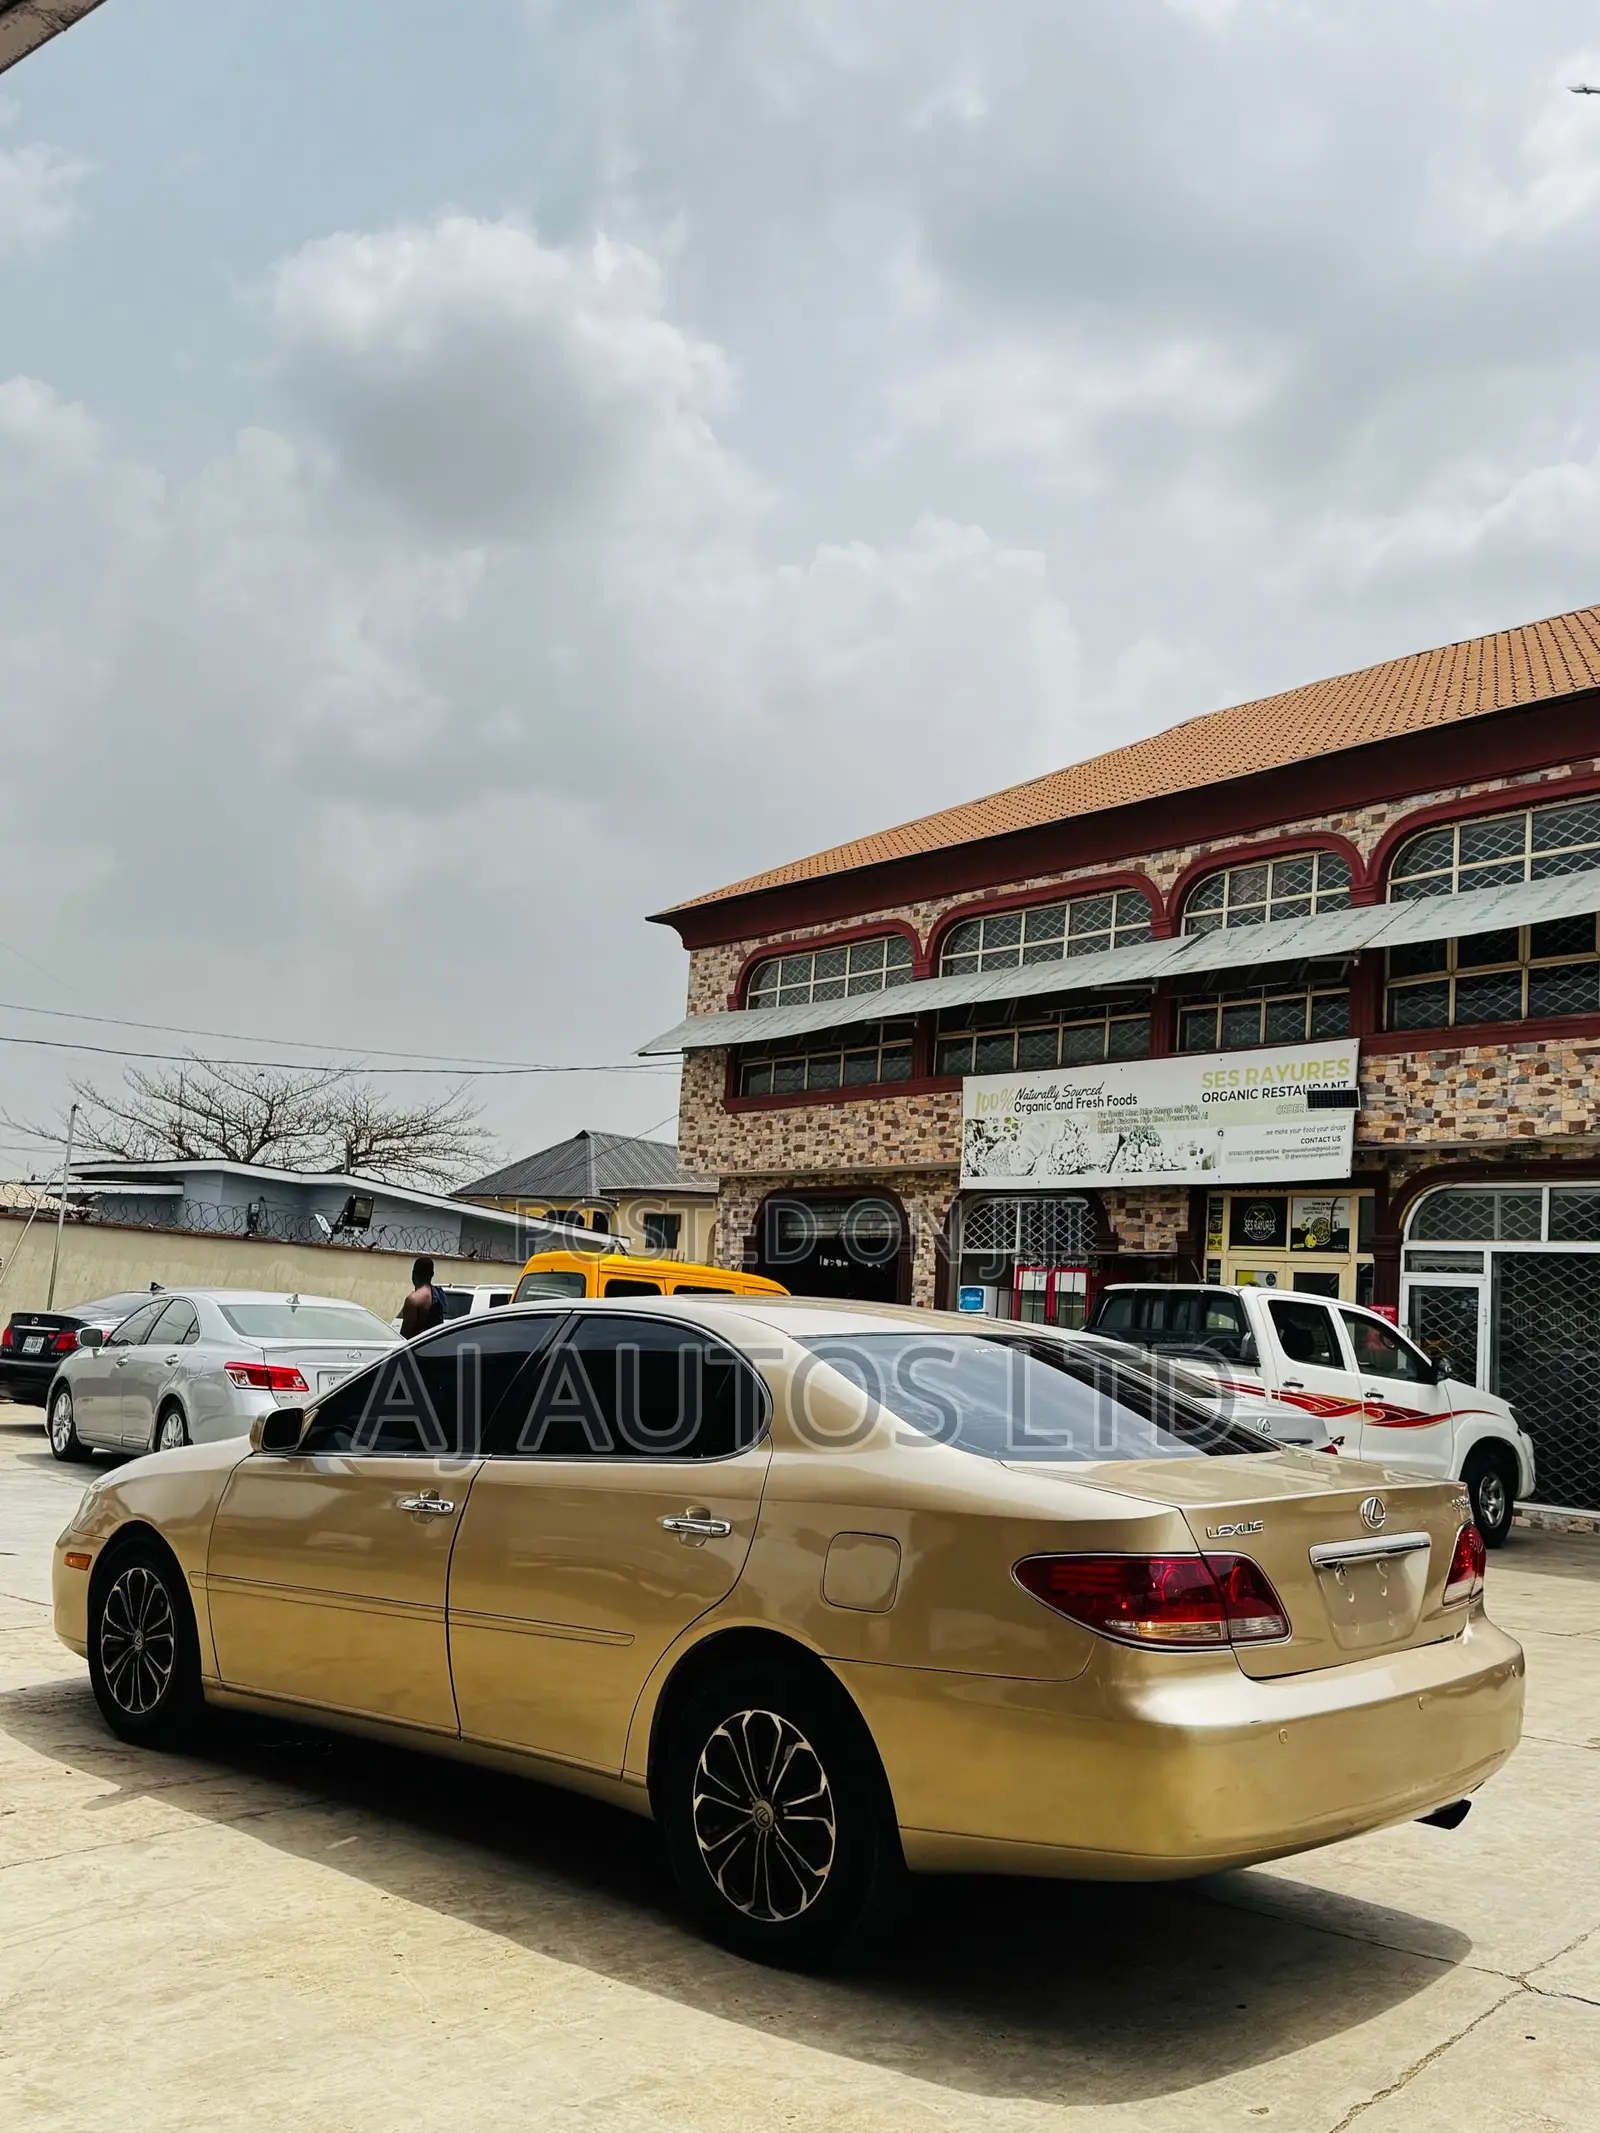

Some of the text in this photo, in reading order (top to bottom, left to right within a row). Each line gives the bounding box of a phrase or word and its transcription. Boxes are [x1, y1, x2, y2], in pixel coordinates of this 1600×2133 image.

[1201, 1058, 1350, 1090] SES RAYURES
[975, 1081, 1105, 1117] 100% Naturally Sourced
[1014, 1093, 1138, 1115] Organic and Fresh Foods
[1201, 1088, 1259, 1103] ORGANIC
[1300, 1135, 1342, 1145] CONTACT US
[1206, 1520, 1265, 1539] LEXUS
